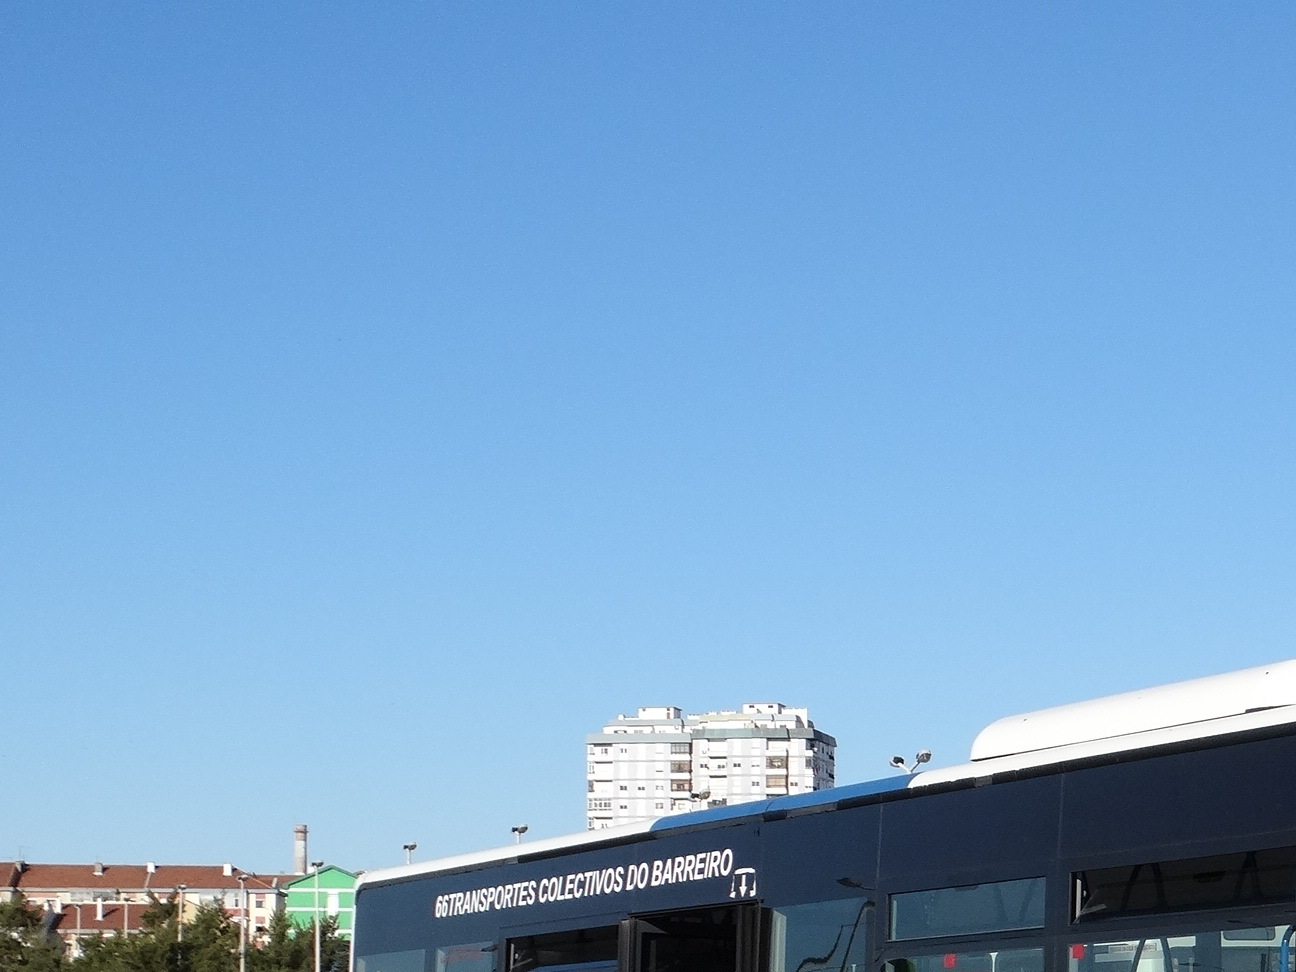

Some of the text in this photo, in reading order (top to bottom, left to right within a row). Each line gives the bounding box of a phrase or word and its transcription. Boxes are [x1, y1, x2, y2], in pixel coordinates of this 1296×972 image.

[538, 865, 625, 904] COLECTIVOS
[626, 862, 649, 891] DO
[650, 848, 733, 887] BARREIRO
